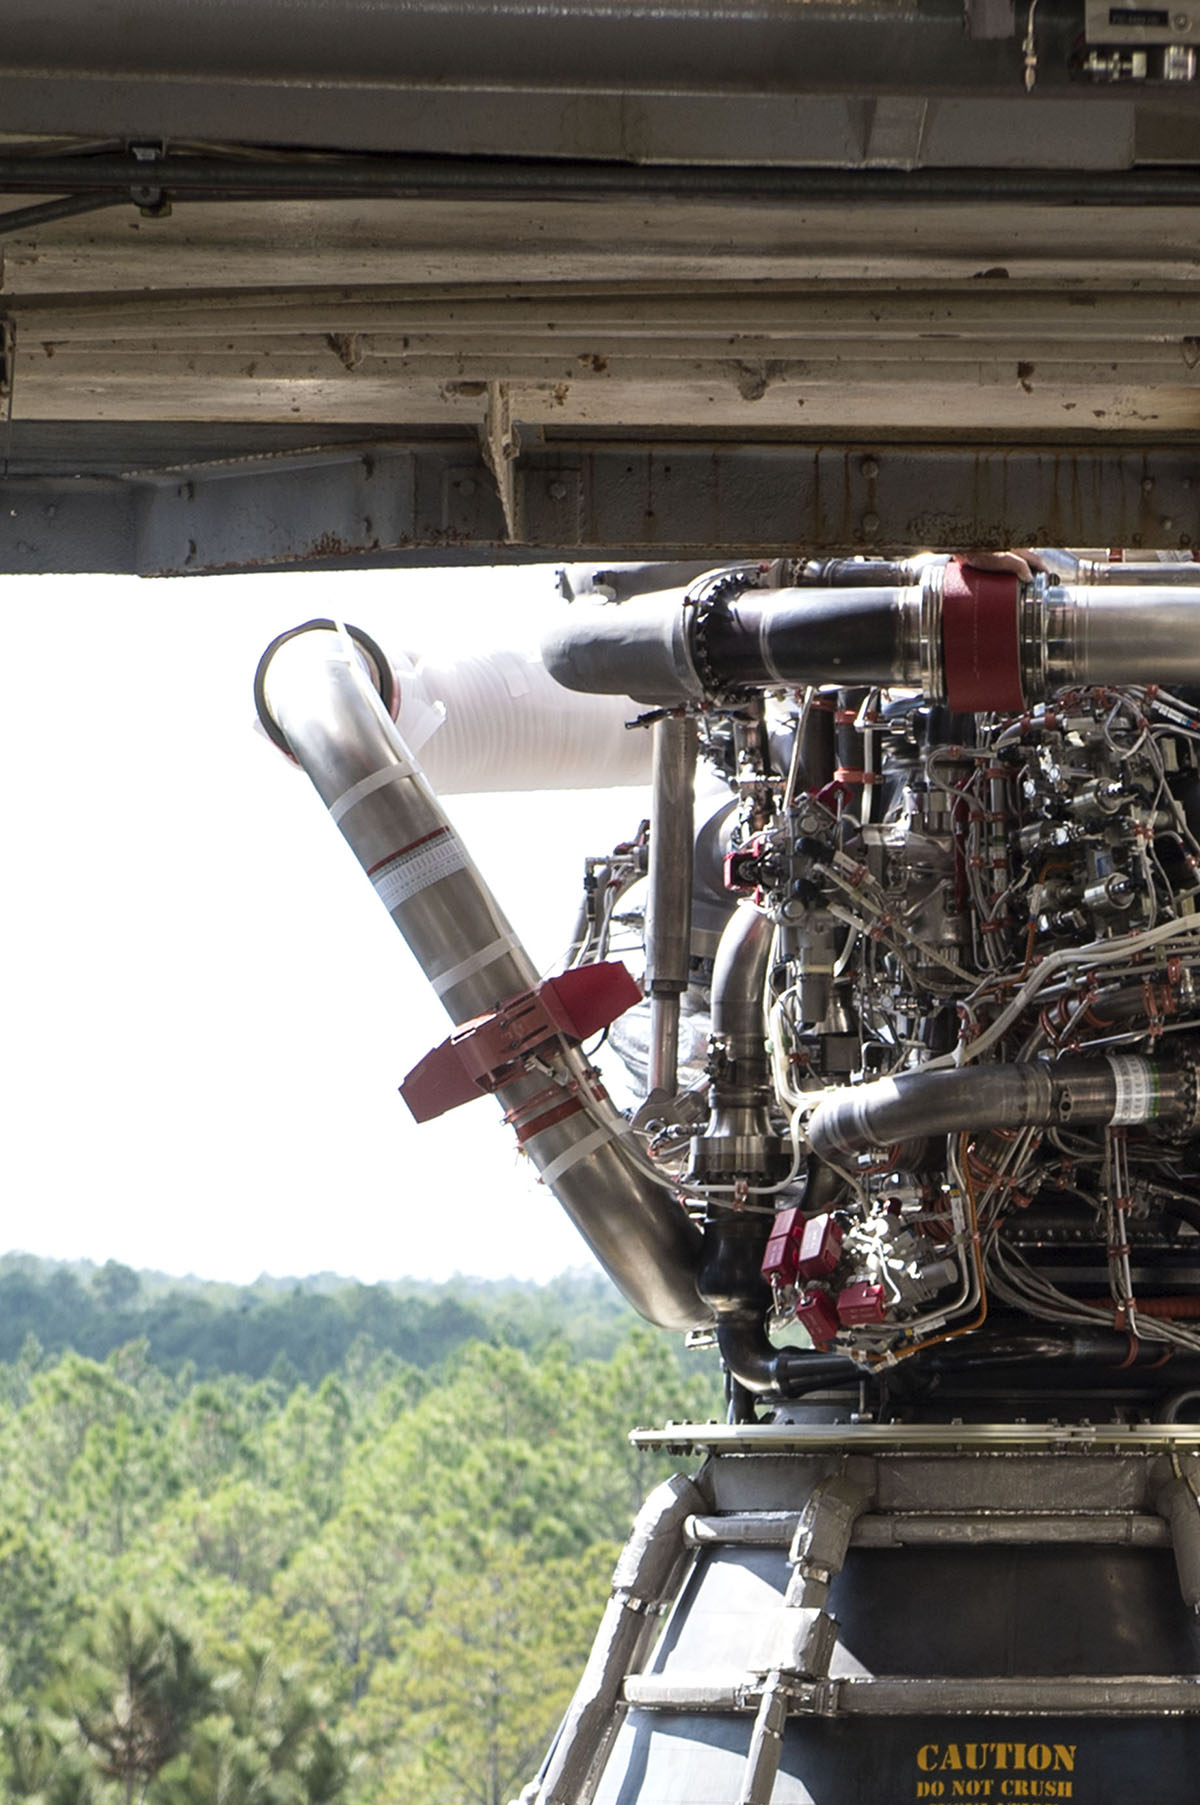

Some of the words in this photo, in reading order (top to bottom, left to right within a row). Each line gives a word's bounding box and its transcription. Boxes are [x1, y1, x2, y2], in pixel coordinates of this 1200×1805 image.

[917, 1742, 1076, 1771] CAUTION
[917, 1781, 944, 1797] DO
[952, 1779, 993, 1796] NOT
[1001, 1780, 1072, 1798] CRUSH
